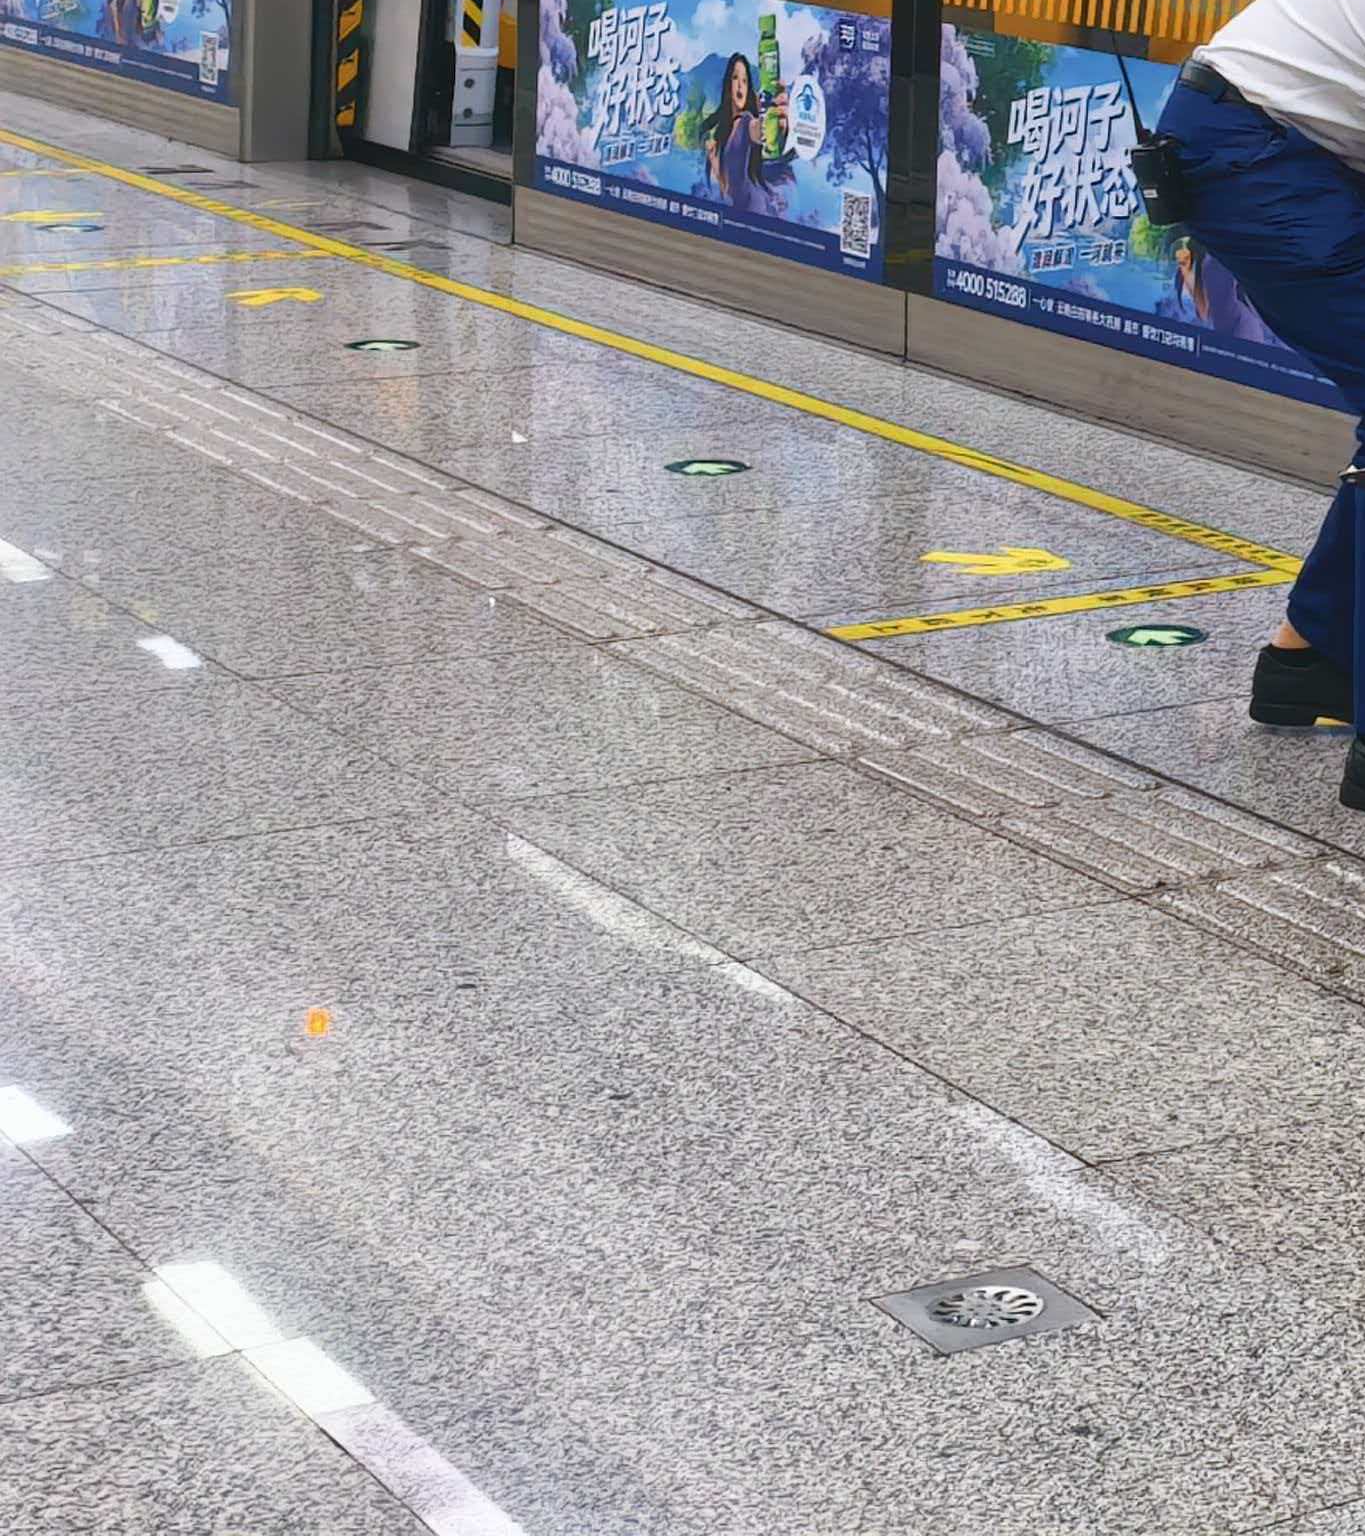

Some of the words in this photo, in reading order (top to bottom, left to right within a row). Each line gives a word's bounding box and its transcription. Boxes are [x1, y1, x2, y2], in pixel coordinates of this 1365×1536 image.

[588, 2, 674, 72] 喝诃子
[1007, 80, 1129, 163] 喝诃子
[1014, 150, 1140, 257] 好状态
[956, 270, 984, 297] 4000
[985, 277, 1028, 309] 515288
